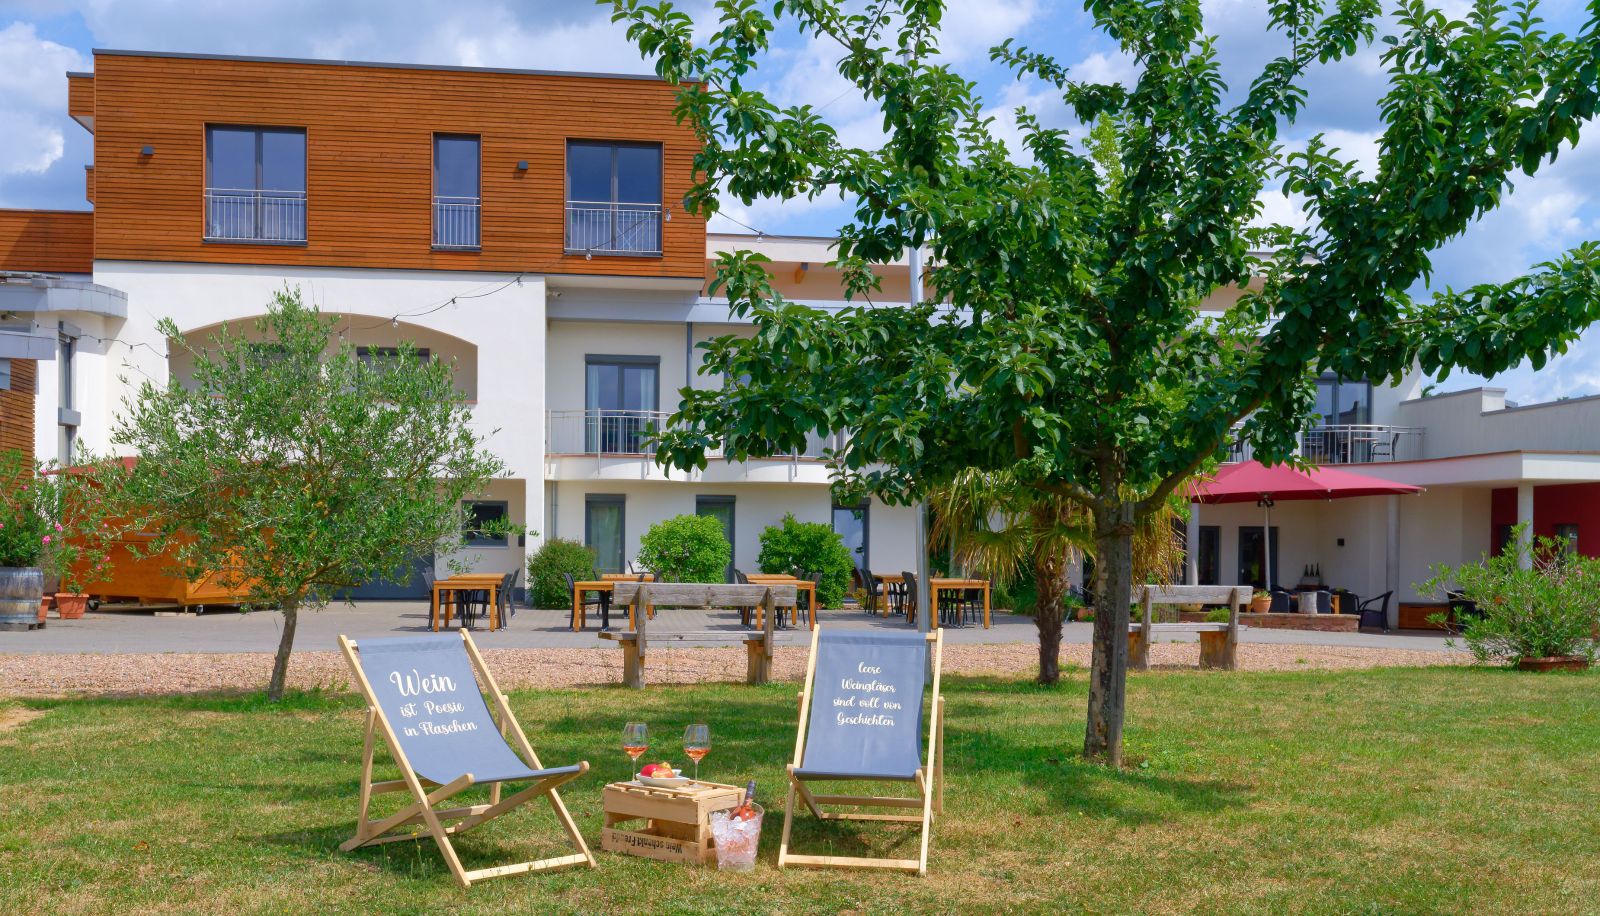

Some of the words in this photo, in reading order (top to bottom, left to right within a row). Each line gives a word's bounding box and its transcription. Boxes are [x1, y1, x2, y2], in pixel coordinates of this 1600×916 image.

[390, 669, 456, 696] Wein
[842, 678, 896, 693] Weingläser
[400, 703, 418, 718] ist
[424, 700, 464, 715] Poesie
[833, 696, 856, 707] sind
[859, 697, 880, 709] voll
[884, 701, 902, 710] von
[838, 712, 895, 726] Geschichten
[404, 727, 419, 737] in
[418, 720, 477, 736] Flaschen
